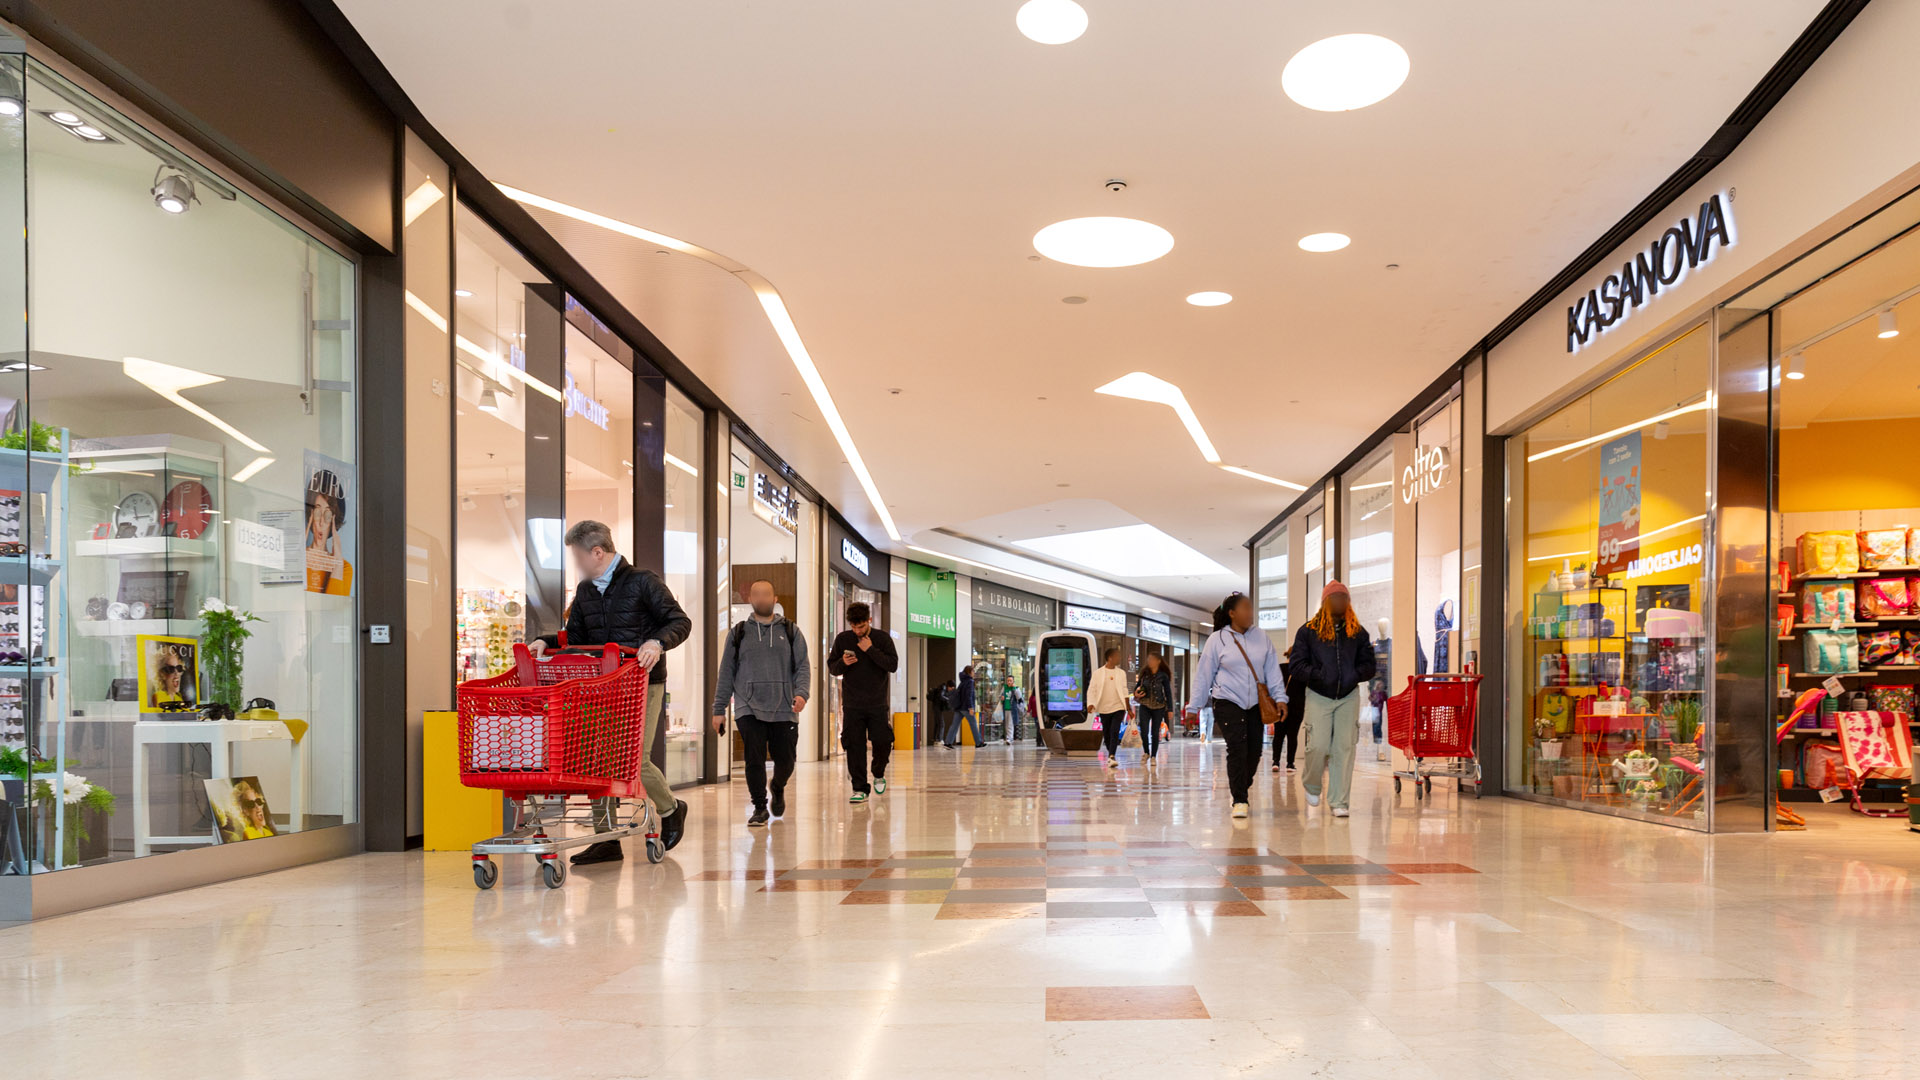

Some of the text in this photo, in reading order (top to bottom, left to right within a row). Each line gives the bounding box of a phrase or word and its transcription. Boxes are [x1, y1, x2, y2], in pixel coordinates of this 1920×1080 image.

[1567, 194, 1730, 353] KASANOVA
[1402, 445, 1444, 505] oltre
[990, 592, 1041, 616] L'ERBOLARIO
[150, 642, 193, 658] GUCCI
